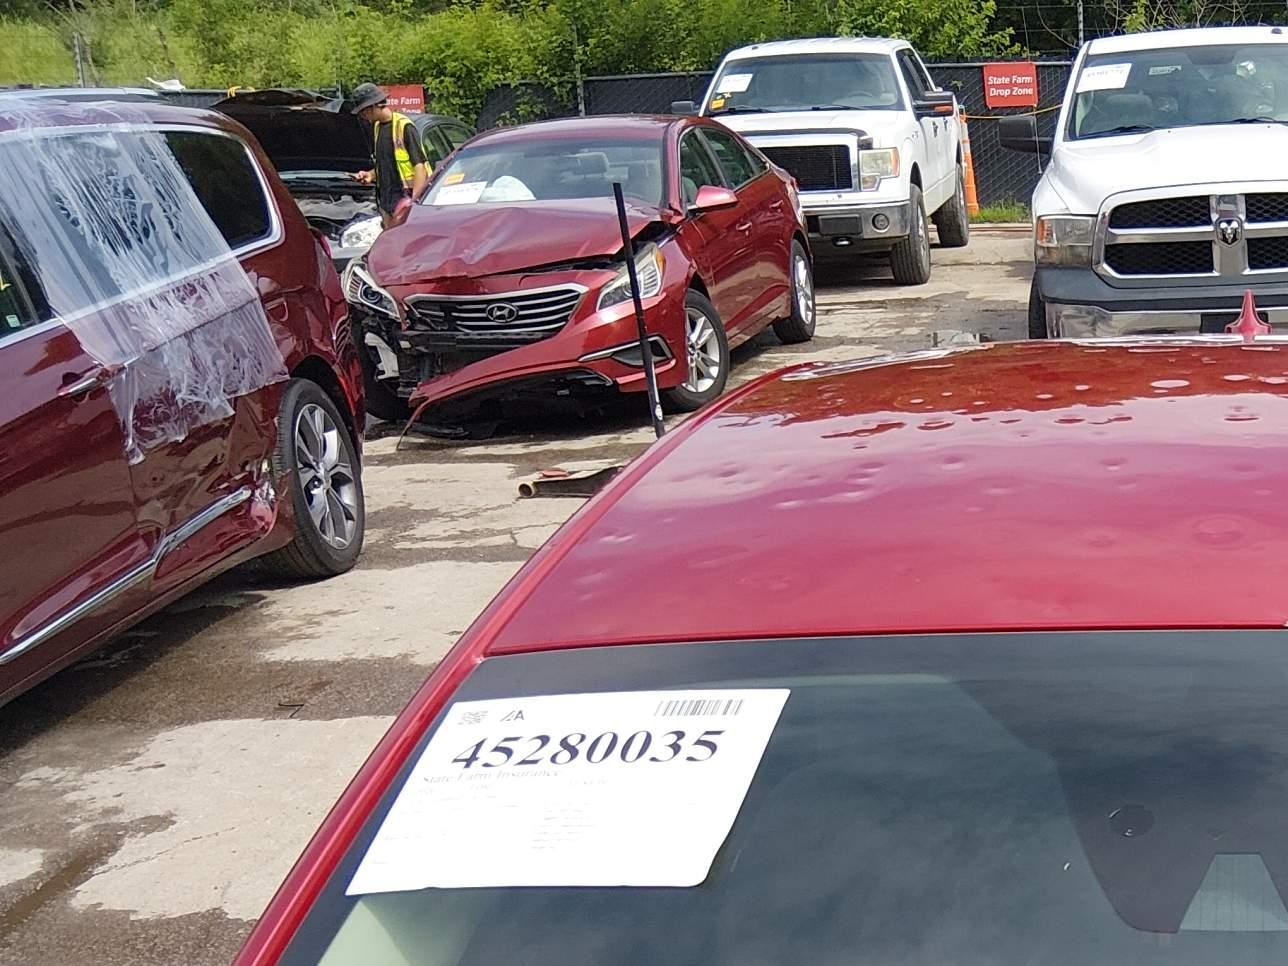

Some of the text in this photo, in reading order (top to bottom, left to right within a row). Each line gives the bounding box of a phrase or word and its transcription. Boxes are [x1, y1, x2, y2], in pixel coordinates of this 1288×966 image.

[988, 75, 1033, 85] State Farm
[990, 87, 1033, 97] Drop Zone
[400, 97, 421, 105] Farm
[451, 729, 727, 769] 45280035
